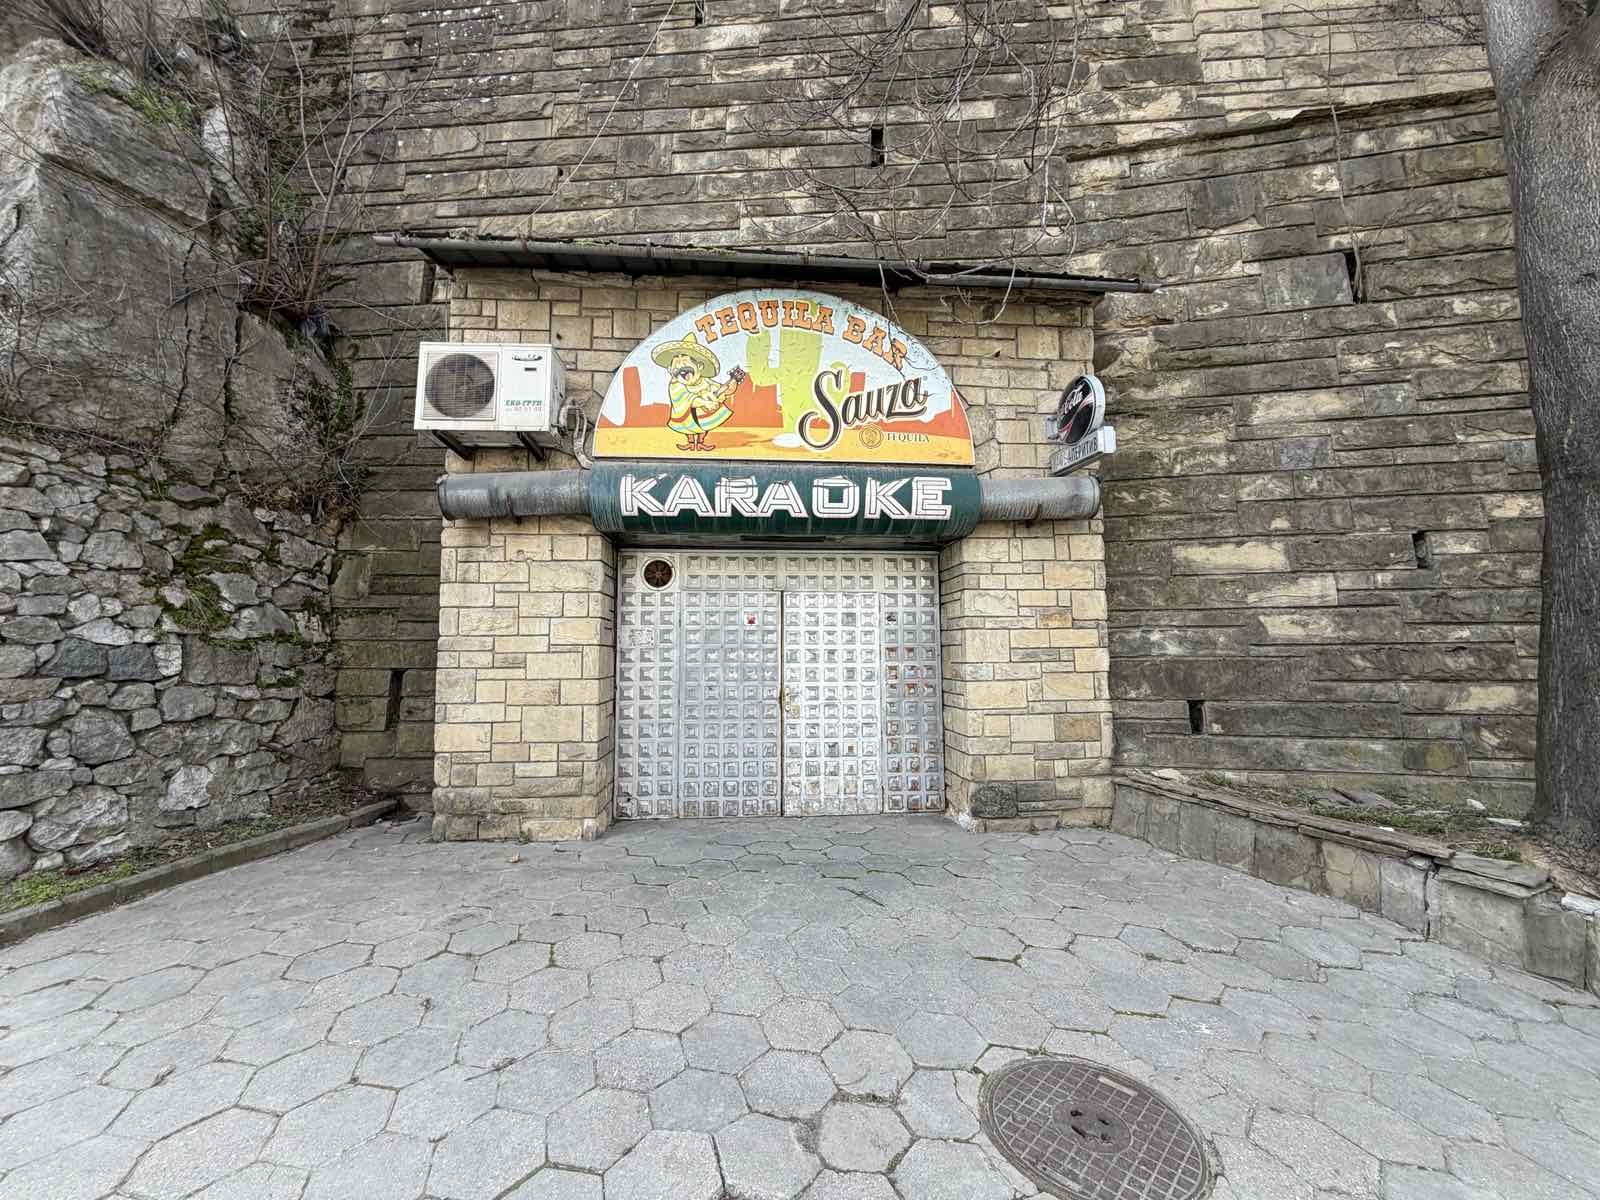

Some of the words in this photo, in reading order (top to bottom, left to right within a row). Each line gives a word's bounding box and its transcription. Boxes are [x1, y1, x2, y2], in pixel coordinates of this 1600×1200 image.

[695, 300, 836, 344] TEQUILA
[842, 315, 909, 371] BAR
[798, 370, 928, 450] Sauza
[887, 432, 930, 443] TEQUILA
[620, 473, 952, 521] KARAOKE
